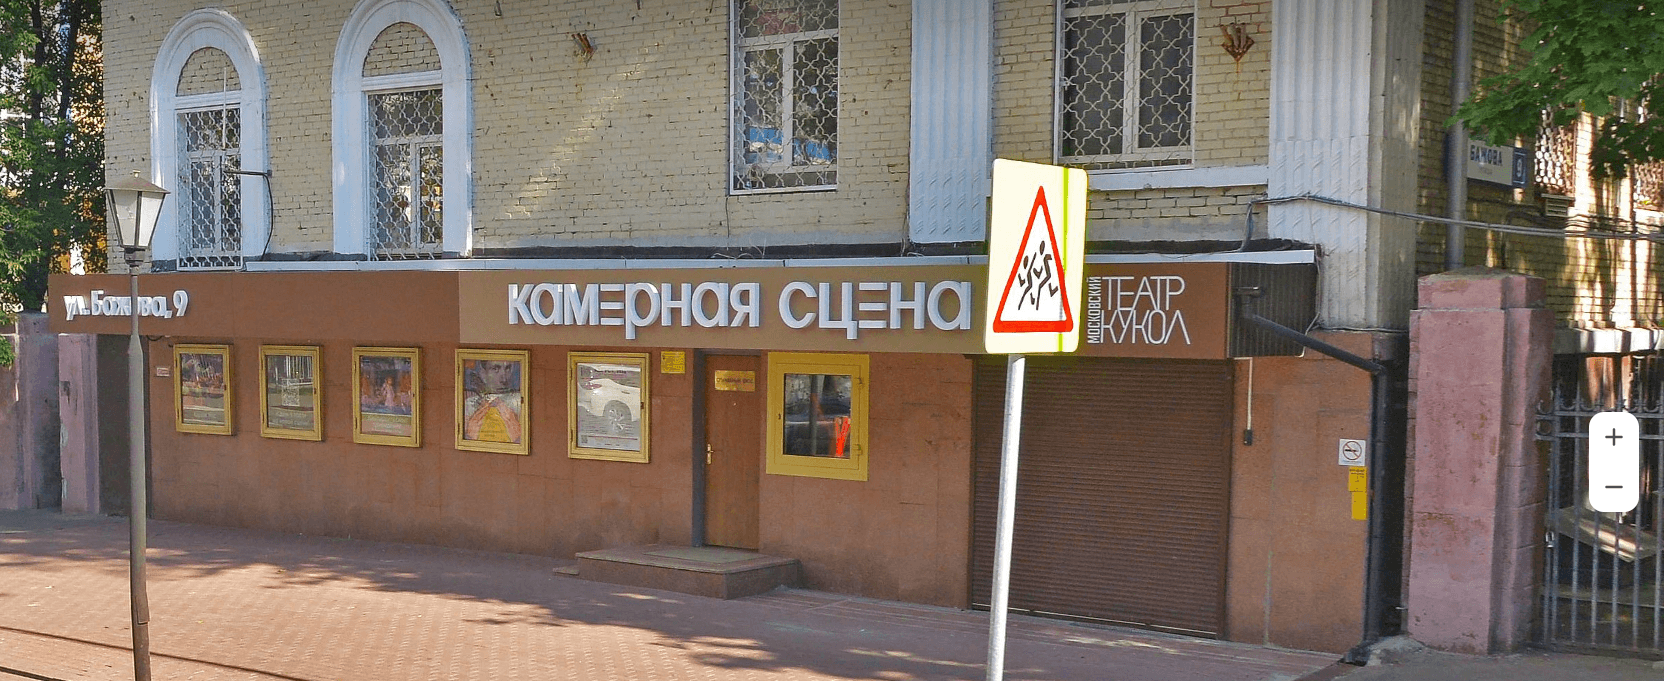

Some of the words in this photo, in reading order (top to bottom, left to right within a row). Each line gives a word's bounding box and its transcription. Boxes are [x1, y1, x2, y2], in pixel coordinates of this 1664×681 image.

[173, 290, 189, 317] 9
[1086, 276, 1102, 344] МОСКОВСКИЙ
[1102, 276, 1186, 311] ТЕАТР
[1100, 309, 1191, 345] КУКОЛ
